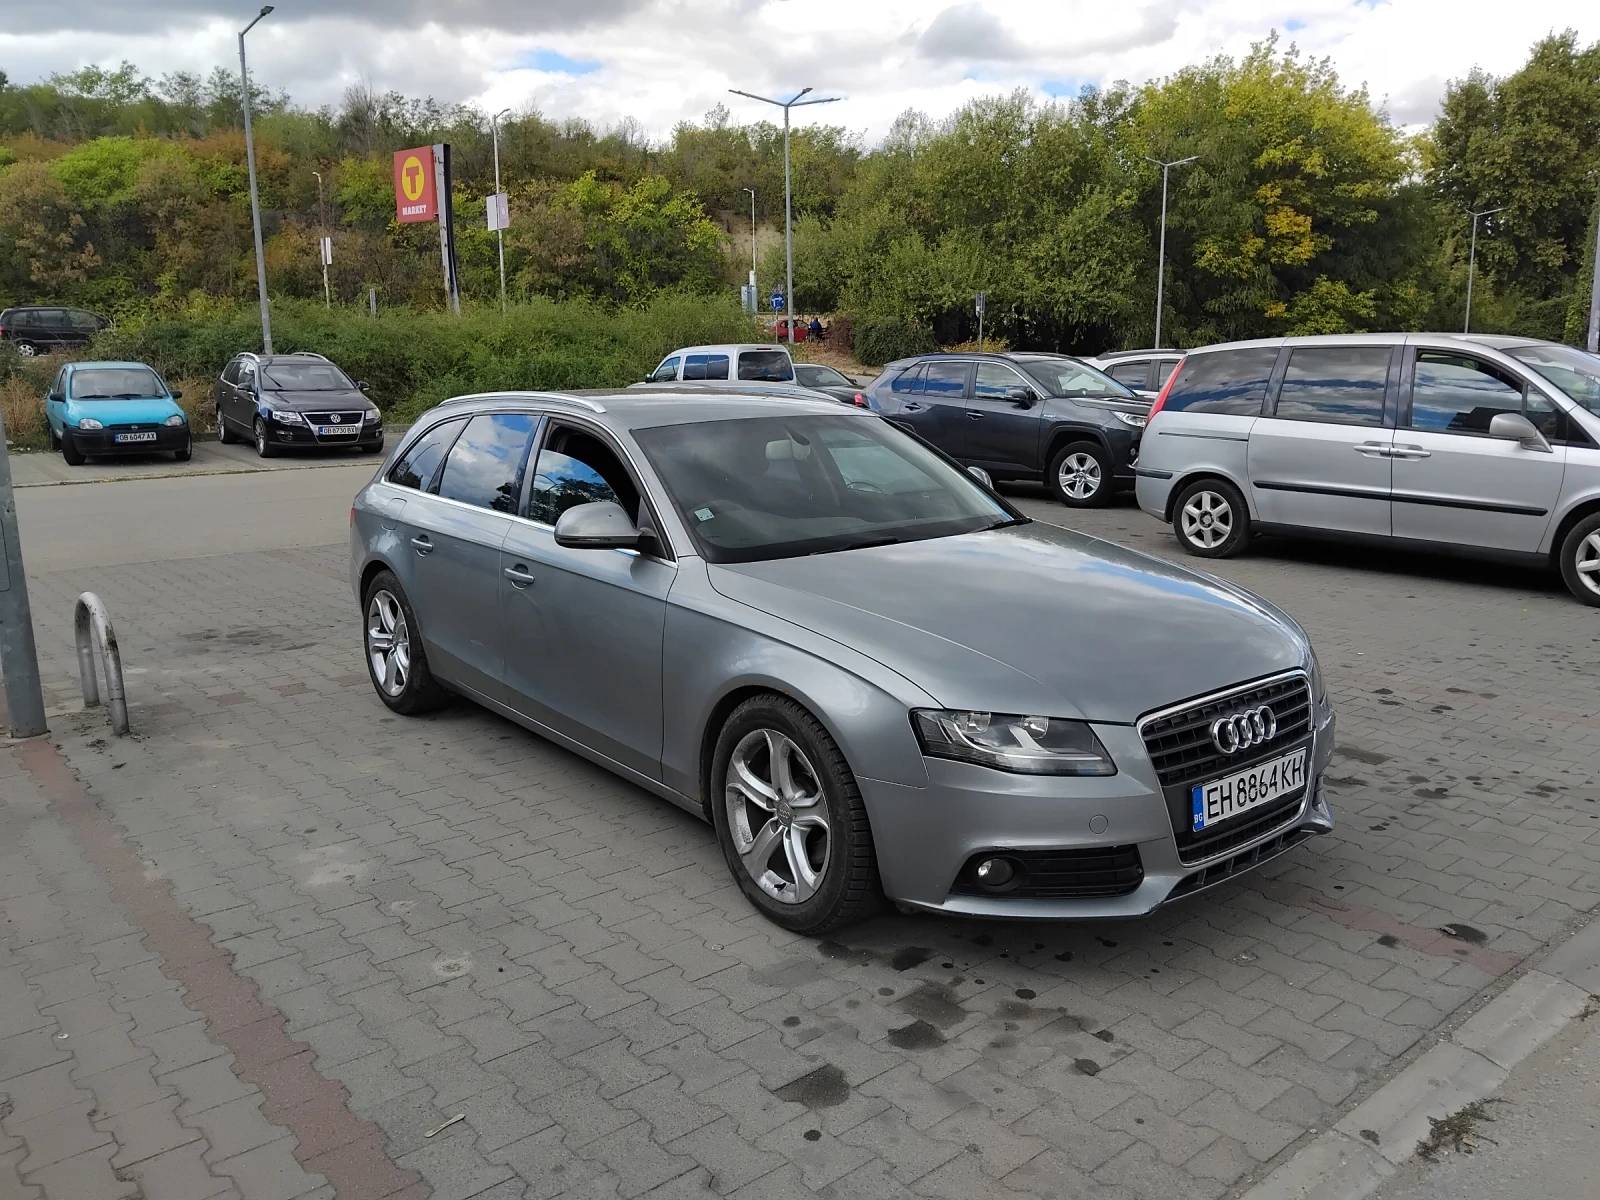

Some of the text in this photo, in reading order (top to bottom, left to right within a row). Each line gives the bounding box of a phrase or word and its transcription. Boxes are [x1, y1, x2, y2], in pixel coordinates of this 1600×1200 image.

[405, 165, 420, 195] T
[402, 204, 427, 216] MARKET
[1193, 812, 1204, 824] BG
